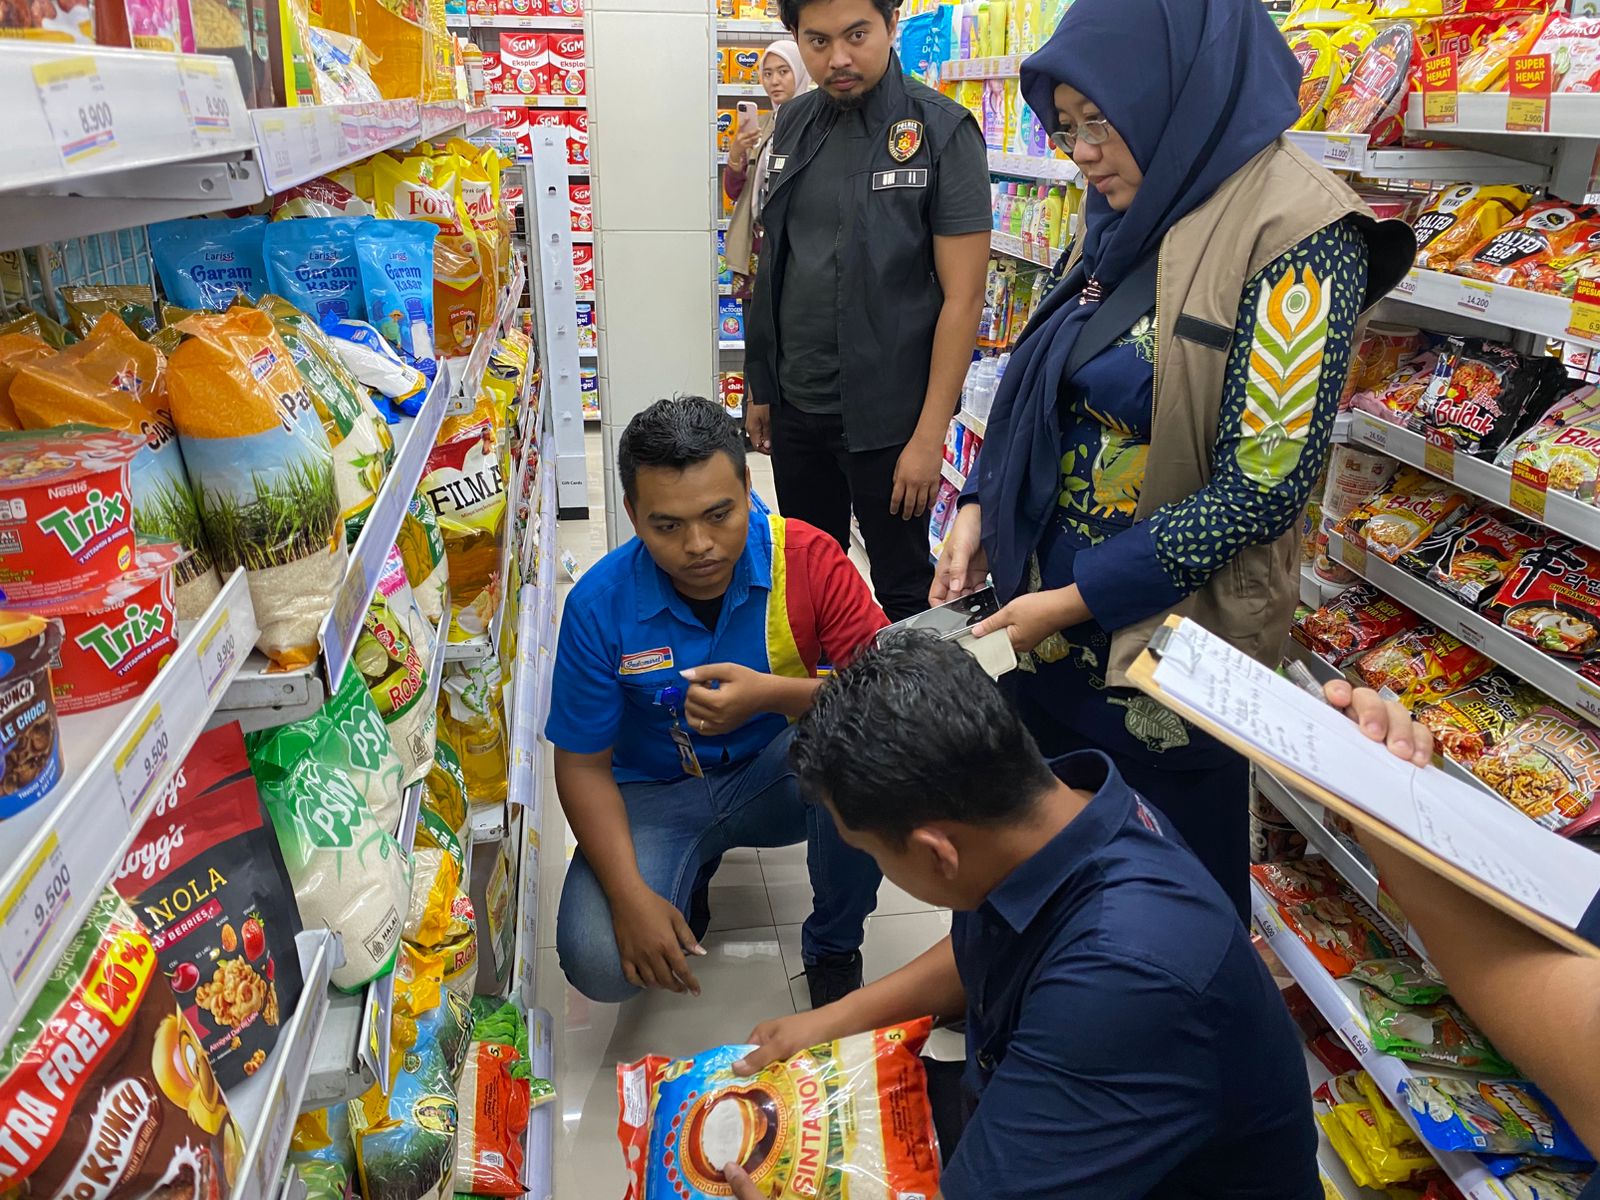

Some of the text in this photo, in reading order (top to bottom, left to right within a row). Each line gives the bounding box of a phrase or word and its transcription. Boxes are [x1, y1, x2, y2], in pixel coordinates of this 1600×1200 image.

[512, 38, 536, 52] SGM
[560, 42, 584, 53] SGM
[482, 57, 494, 66] GM
[1425, 56, 1452, 72] SUPER
[1514, 58, 1545, 70] SUPER
[1426, 67, 1452, 82] HEMAT
[1515, 71, 1546, 82] HEMAT
[206, 96, 230, 118] 8.900
[1440, 104, 1456, 113] 2.900
[78, 101, 114, 134] 8.900
[540, 116, 559, 126] SGM
[1524, 114, 1542, 122] 2.900
[574, 191, 591, 200] SGM
[1414, 212, 1454, 231] SALTED
[1414, 228, 1433, 243] EGG
[1492, 232, 1543, 254] SALTED
[572, 250, 584, 258] GM
[1486, 244, 1518, 260] EGG
[190, 264, 252, 282] Garam
[295, 264, 357, 283] Garam
[385, 264, 422, 280] Garam
[394, 279, 422, 292] Kasar
[1400, 282, 1416, 291] 4.200
[1577, 286, 1600, 298] SPESIA
[1578, 279, 1596, 288] HARGA
[1467, 295, 1490, 308] 14.200
[1435, 398, 1494, 436] Buldak
[1514, 469, 1538, 484] SPESIAL
[426, 464, 504, 517] FILMA
[1384, 494, 1443, 525] Buldak
[36, 489, 125, 557] Trix
[84, 540, 108, 560] VITAMIN
[1550, 584, 1598, 606] SHIN RAMYUN
[74, 604, 165, 670] Trix
[216, 634, 235, 668] 9.900
[123, 652, 147, 674] VITAMIN
[626, 656, 661, 669] Indomaret
[16, 700, 47, 730] CHOCO
[1468, 701, 1498, 728] SHIN
[144, 731, 169, 778] 9.500
[34, 864, 71, 927] 9.500
[168, 908, 208, 942] BERRIES
[382, 917, 398, 940] HALAL
[1262, 920, 1276, 938] 6.500
[93, 942, 148, 1013] 40%
[209, 1034, 232, 1053] Almond
[1352, 1034, 1368, 1054] 6.500
[37, 1010, 110, 1101] FREE
[80, 1082, 146, 1187] KRUNCH
